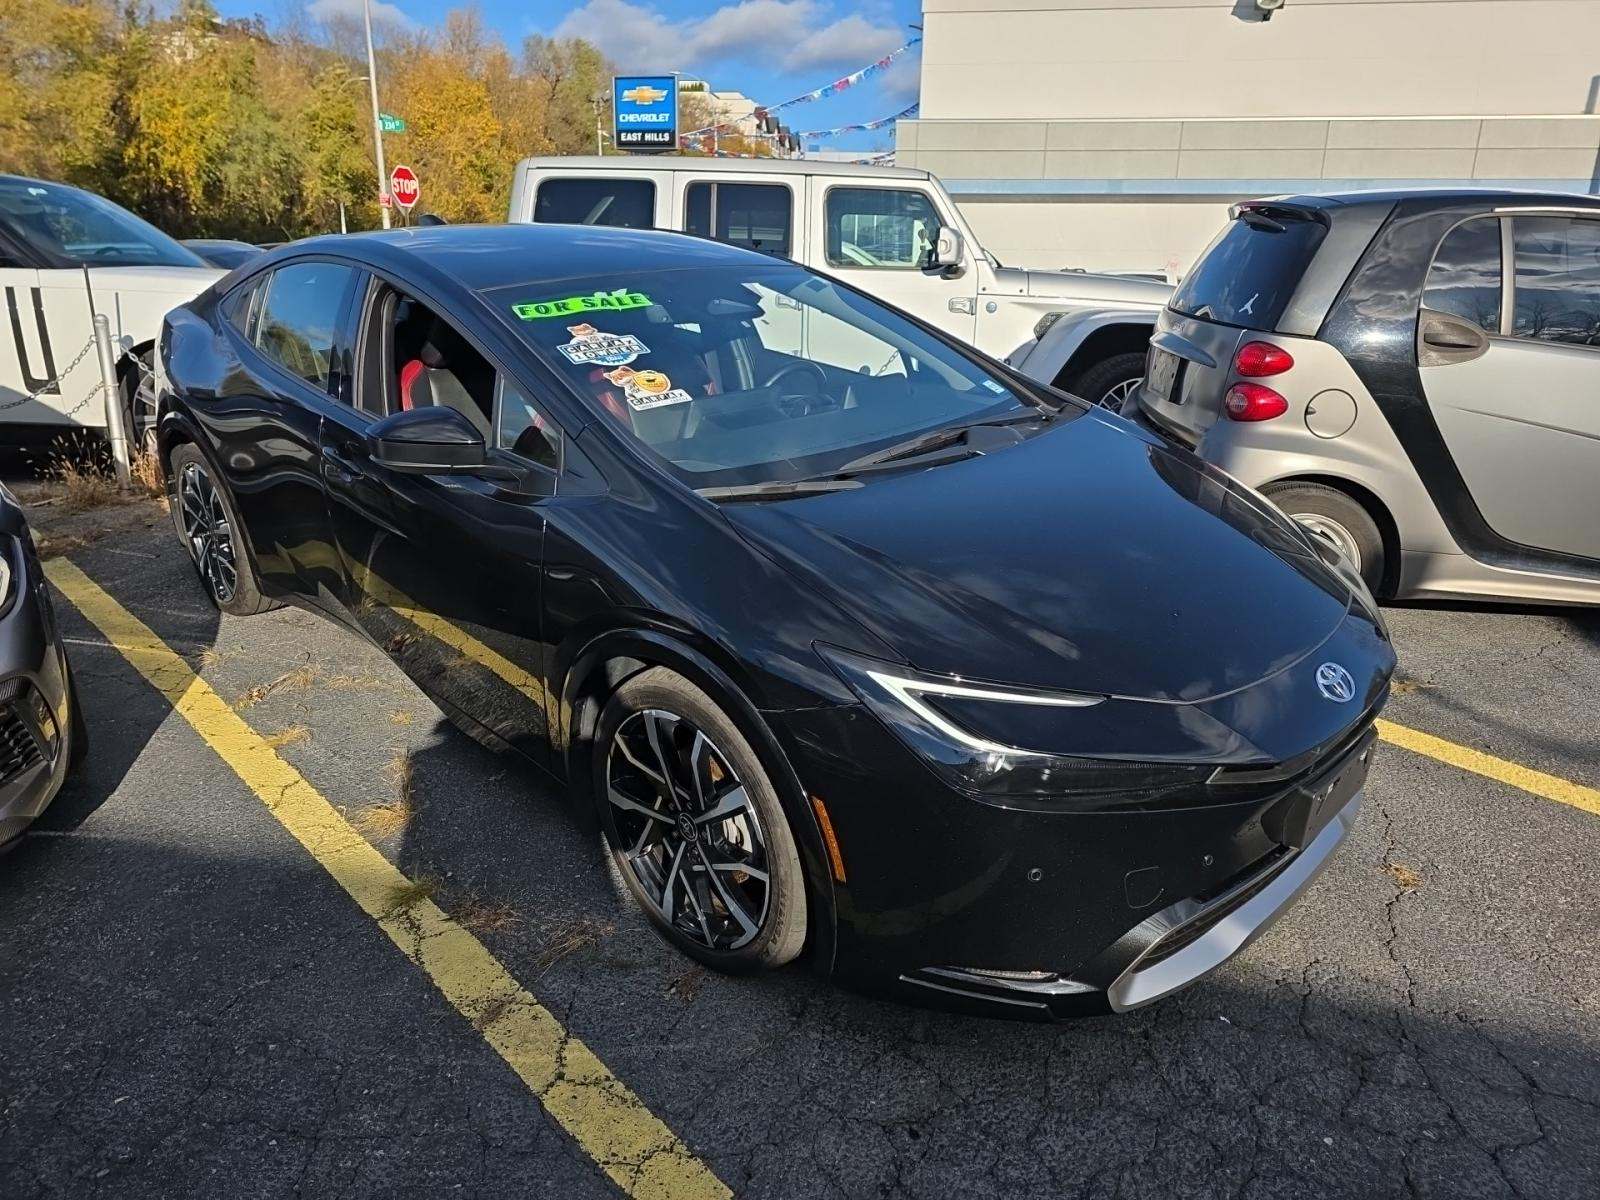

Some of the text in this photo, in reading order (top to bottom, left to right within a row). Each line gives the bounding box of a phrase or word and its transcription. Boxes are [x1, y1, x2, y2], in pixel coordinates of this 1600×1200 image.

[619, 113, 670, 123] CHEVROLET
[621, 132, 670, 142] EAST HILLS
[393, 178, 417, 195] STOP
[518, 295, 643, 316] FOR SALE
[565, 339, 633, 354] CARFAX
[631, 392, 683, 406] CARFAX
